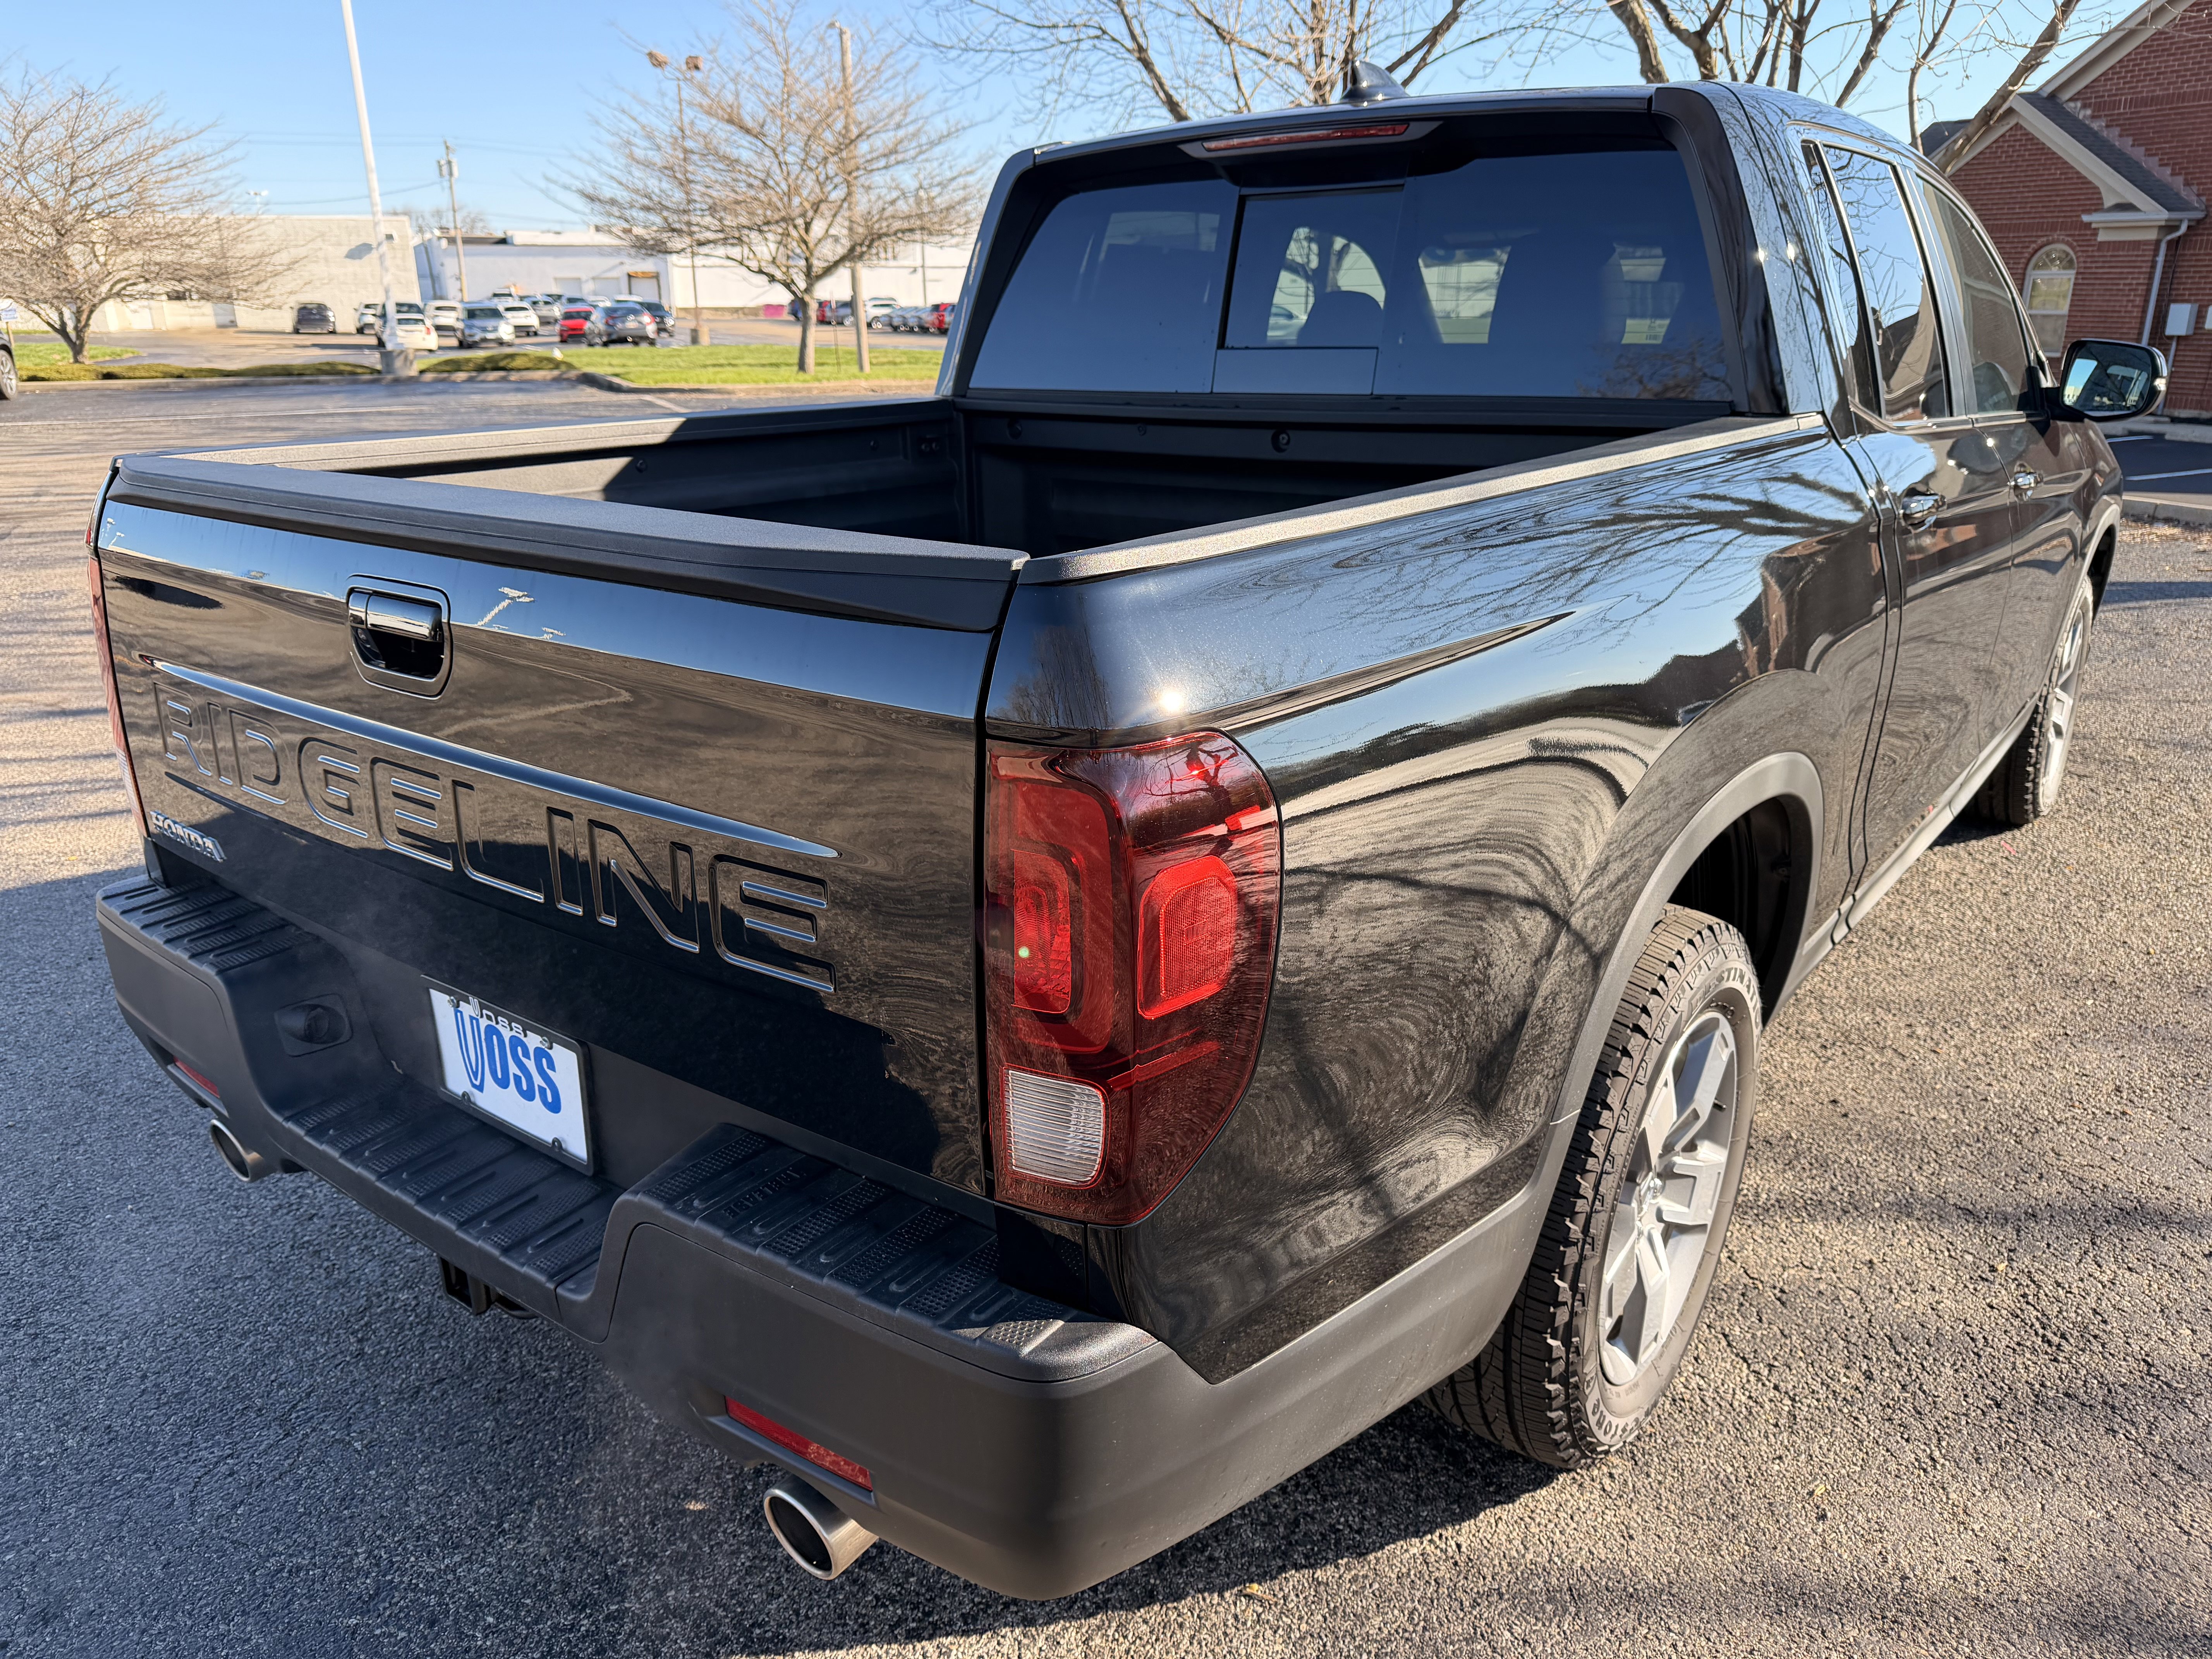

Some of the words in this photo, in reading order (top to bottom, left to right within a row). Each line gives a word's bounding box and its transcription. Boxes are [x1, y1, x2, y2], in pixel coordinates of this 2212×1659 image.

[150, 811, 227, 863] HONDA
[153, 682, 837, 993] RIDGELINE
[722, 1172, 799, 1219] RELEASE
[1591, 1390, 1662, 1443] estone
